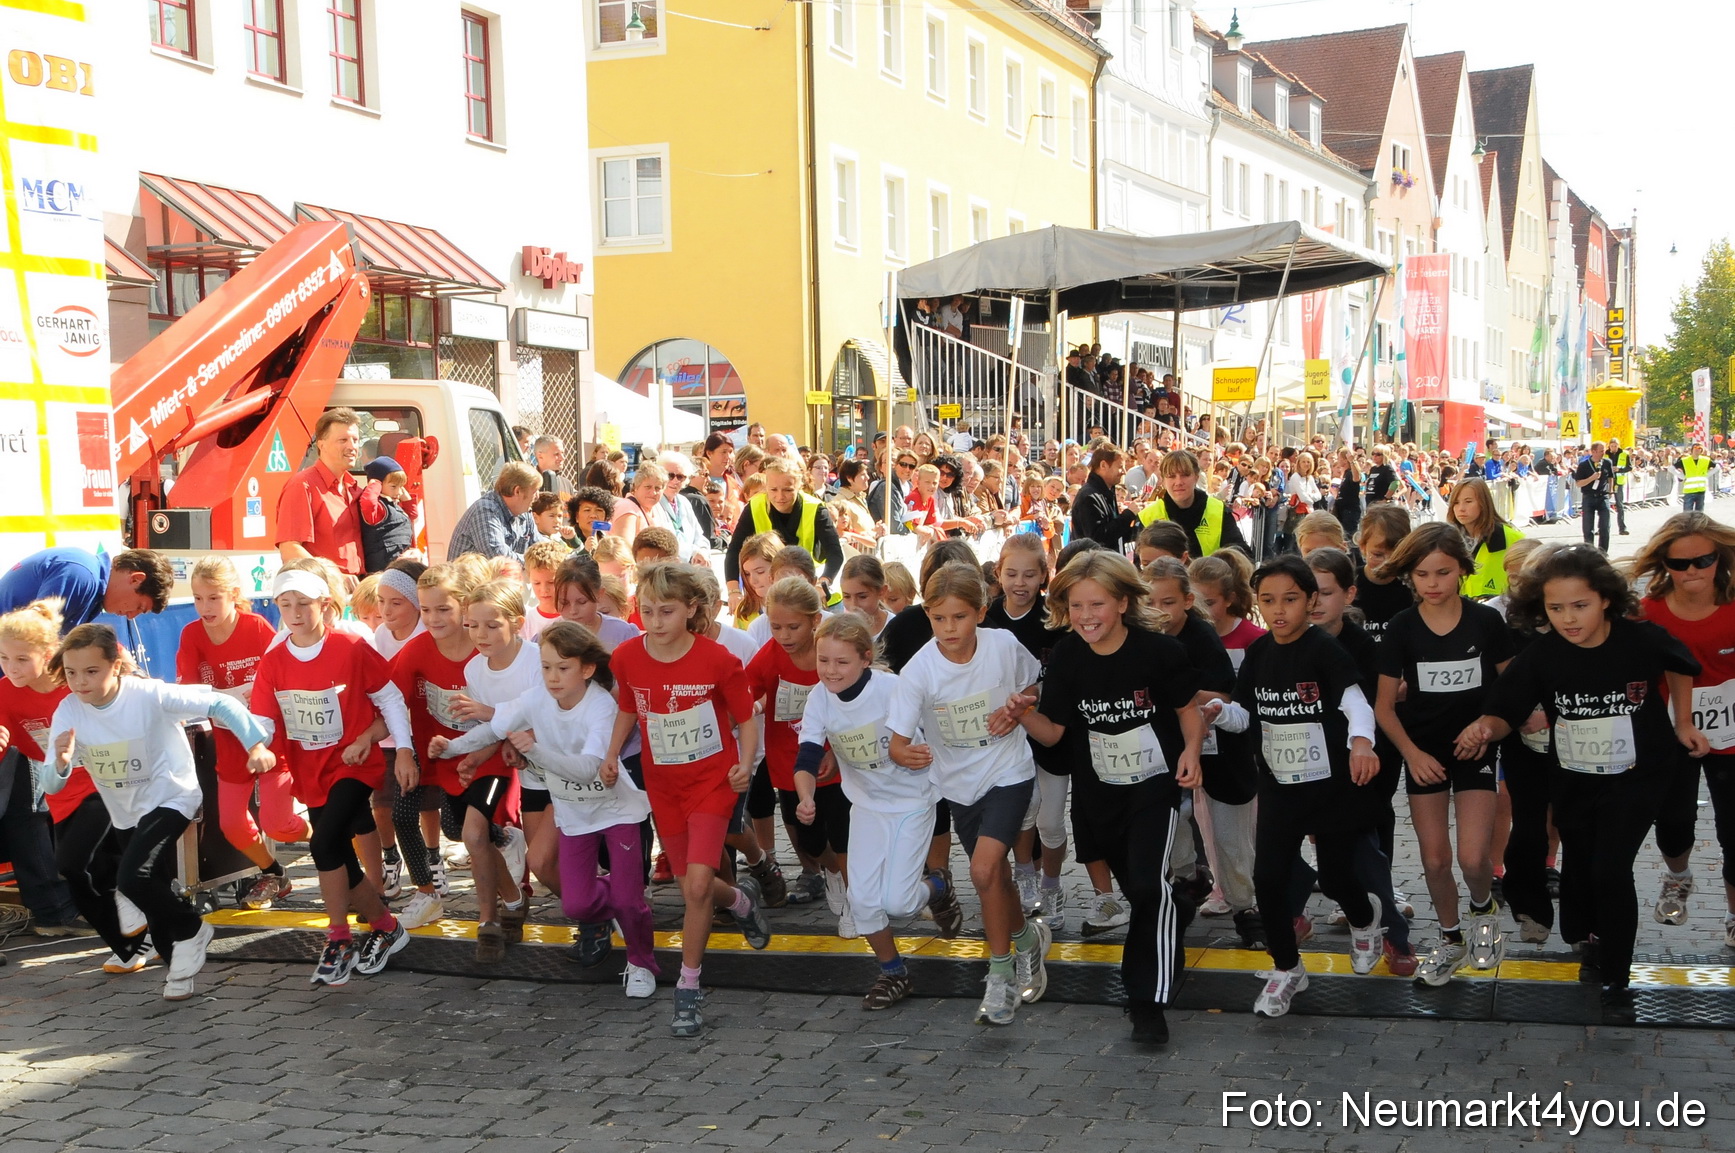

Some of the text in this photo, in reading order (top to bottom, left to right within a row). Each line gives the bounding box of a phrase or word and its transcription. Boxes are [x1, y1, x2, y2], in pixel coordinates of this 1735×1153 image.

[8, 49, 95, 97] OBI
[37, 316, 91, 330] GERHART
[64, 332, 100, 345] JANIG
[1305, 370, 1329, 379] Jugend-
[187, 376, 198, 397] &
[1564, 419, 1575, 432] A
[1428, 668, 1475, 686] 7327
[294, 694, 330, 705] Christina
[1114, 698, 1134, 709] ein
[1603, 691, 1626, 704] ein
[1699, 691, 1723, 707] Eva
[952, 700, 986, 714] Teresa
[298, 709, 335, 725] 7167
[663, 718, 686, 728] Anna
[667, 724, 713, 747] 7175
[1271, 730, 1310, 741] Lucienne
[1571, 725, 1598, 735] Flora
[839, 733, 864, 743] Elena
[1103, 738, 1118, 749] Eva
[90, 748, 110, 757] Lisa
[846, 736, 890, 758] 7178
[1575, 739, 1627, 756] 7022
[1107, 748, 1154, 768] 7177
[1273, 745, 1321, 764] 7026
[95, 758, 142, 774] 7179
